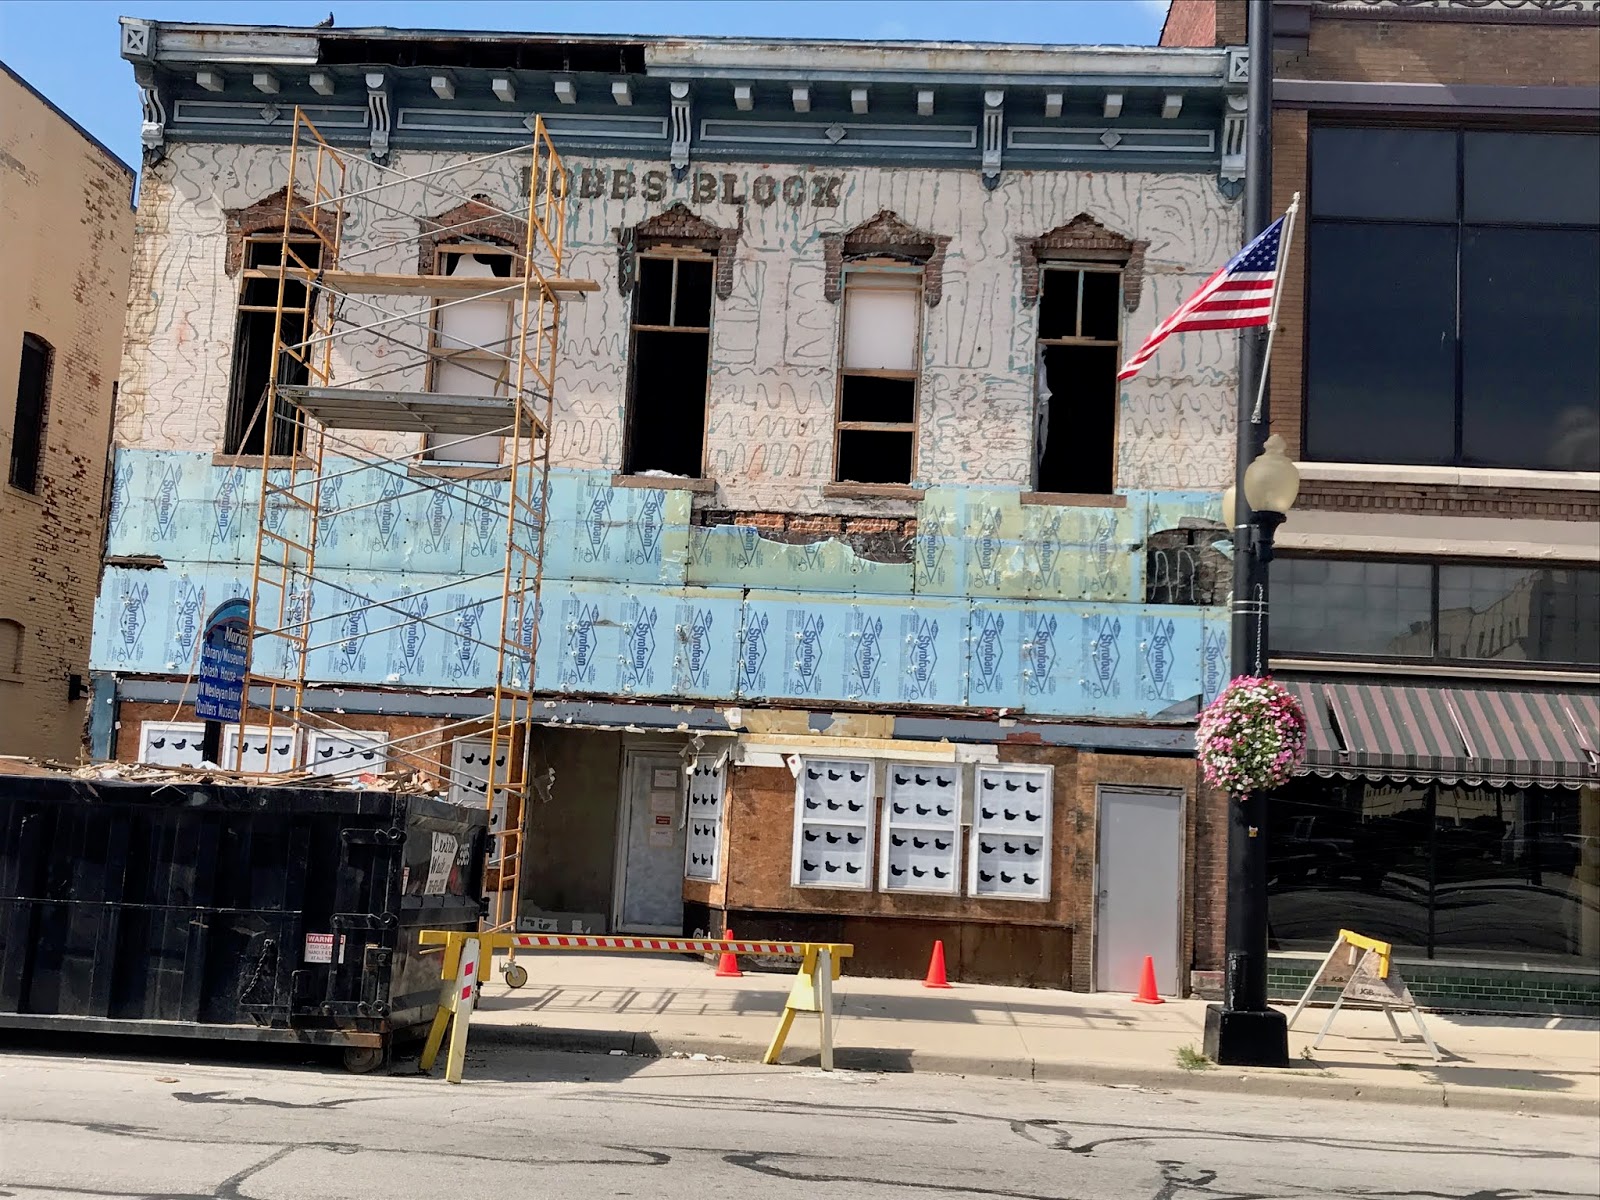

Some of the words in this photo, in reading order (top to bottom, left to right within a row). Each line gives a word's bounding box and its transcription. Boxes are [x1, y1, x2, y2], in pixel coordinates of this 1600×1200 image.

[691, 172, 843, 208] BLOCK
[160, 480, 175, 524] Styrofoam
[220, 482, 234, 527] Styrofoam
[592, 500, 606, 545] Styrofoam
[643, 501, 657, 547] Styrofoam
[125, 598, 140, 644] Styrofoam
[183, 601, 198, 647] Styrofoam
[577, 620, 591, 667] Styrofoam
[635, 622, 650, 669] Styrofoam
[691, 625, 705, 671] Styrofoam
[747, 627, 761, 674] Styrofoam
[802, 630, 817, 677] Styrofoam
[861, 632, 875, 679] Styrofoam
[916, 635, 931, 682] Styrofoam
[983, 629, 997, 676] Styrofoam
[1035, 631, 1050, 677] Styrofoam
[1099, 634, 1113, 681] Styrofoam
[1152, 635, 1167, 683] Styrofoam
[201, 661, 219, 679] Splash
[221, 666, 237, 682] House
[205, 682, 229, 701] Wesleyan
[1205, 646, 1219, 694] Styrofoam
[218, 703, 239, 720] Museum
[308, 935, 344, 944] WARNIG
